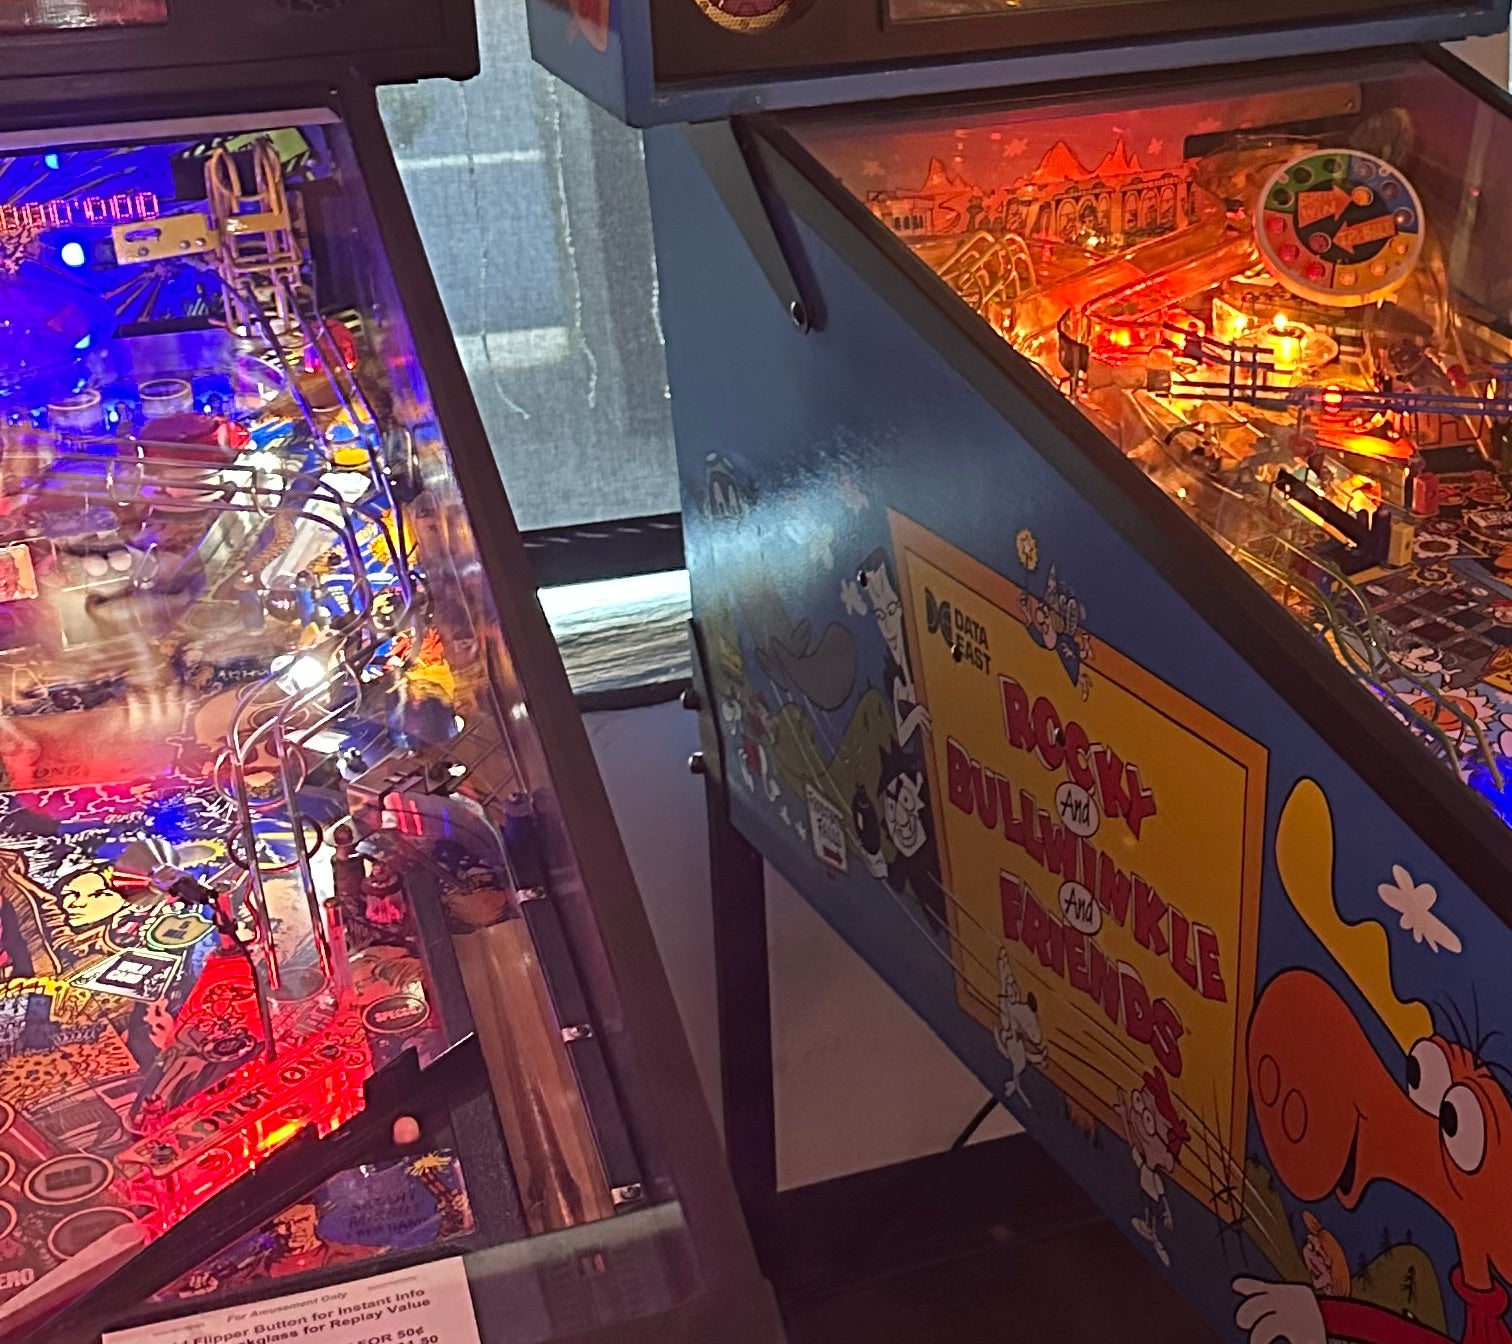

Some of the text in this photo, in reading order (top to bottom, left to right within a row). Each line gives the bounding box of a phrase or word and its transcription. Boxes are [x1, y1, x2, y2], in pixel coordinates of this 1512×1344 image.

[955, 607, 989, 650] DATA
[955, 634, 991, 676] EAST
[998, 674, 1155, 839] ROCKY
[1061, 792, 1091, 826] And
[946, 738, 1227, 1003] BULLWINKLE
[1065, 888, 1094, 924] And
[1000, 869, 1186, 1076] FRIENDS
[375, 1007, 423, 1023] SPECIAL
[176, 1087, 271, 1150] ADMT
[227, 1290, 348, 1323] For Amusement Only
[254, 1316, 307, 1335] Button
[312, 1308, 335, 1323] for
[338, 1294, 393, 1314] Instant
[396, 1288, 425, 1304] Info
[303, 1323, 325, 1337] for
[329, 1308, 383, 1330] Replay
[386, 1297, 431, 1314] Value
[396, 1325, 425, 1340] 50¢
